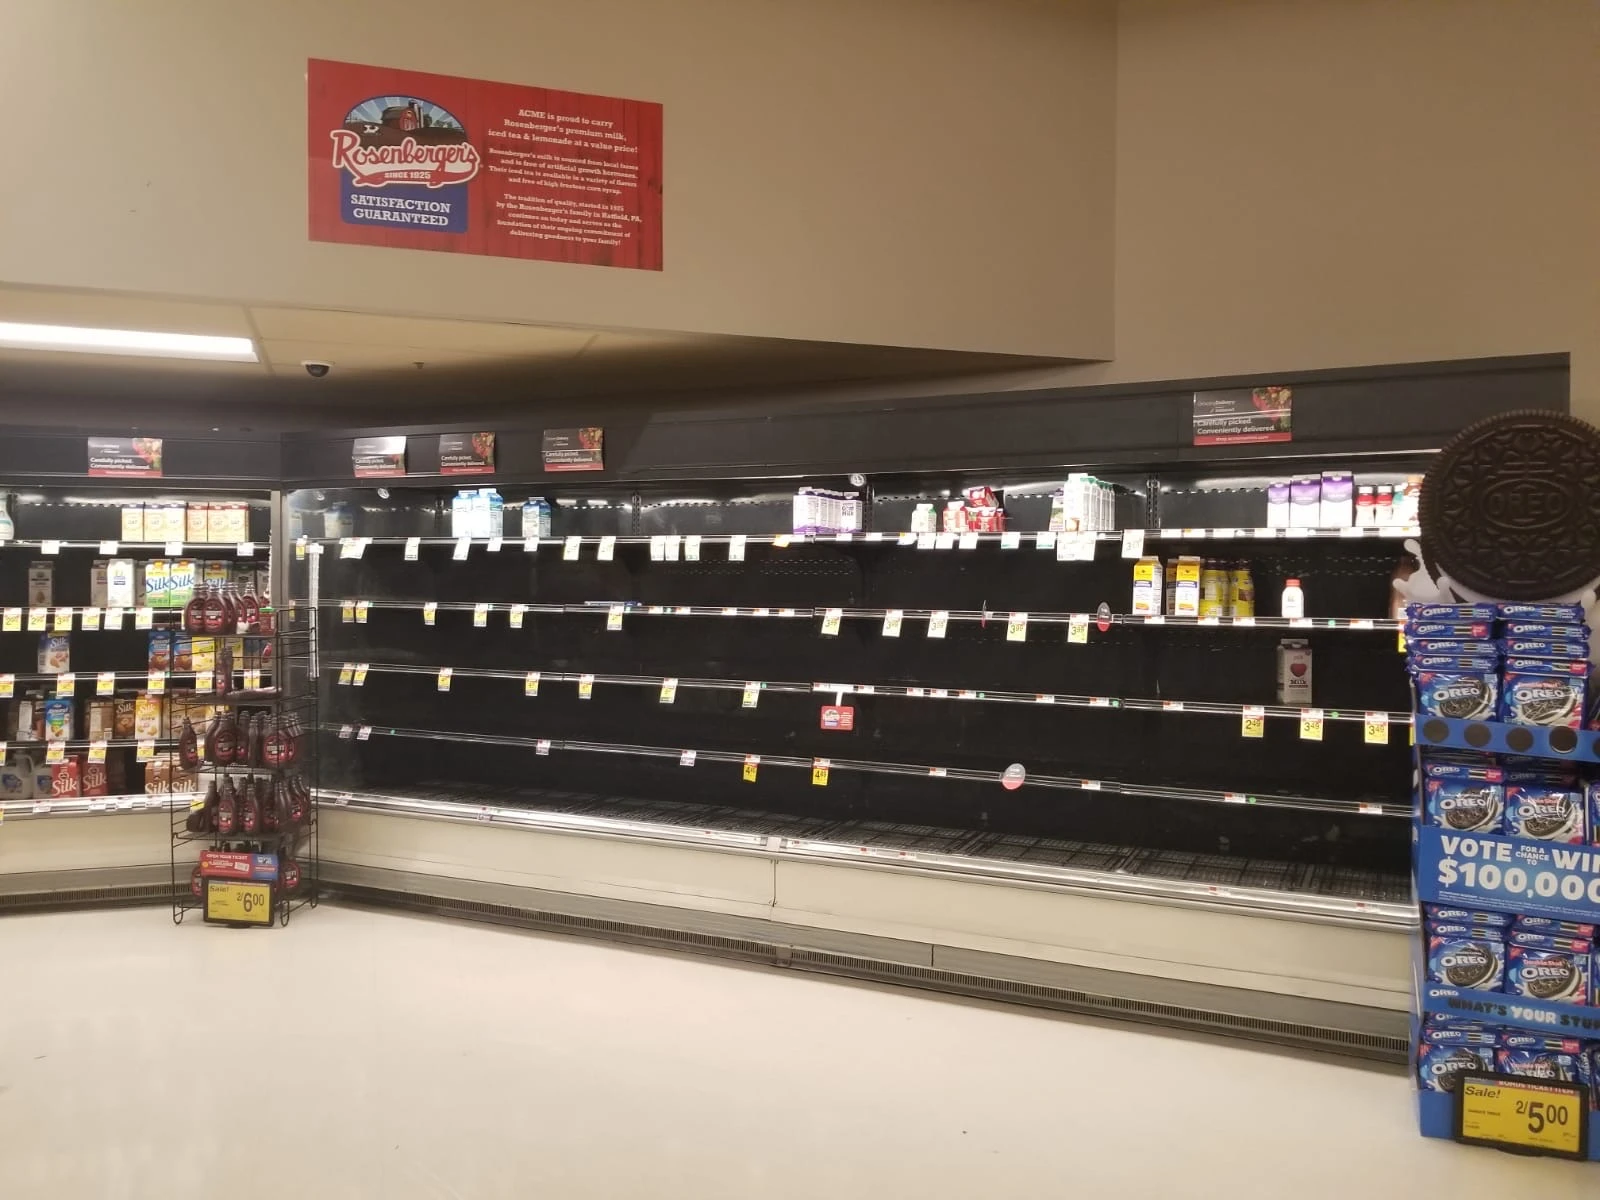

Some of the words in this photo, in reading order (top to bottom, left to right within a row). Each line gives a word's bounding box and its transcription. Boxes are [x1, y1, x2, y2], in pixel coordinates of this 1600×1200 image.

[518, 109, 546, 118] ACME
[591, 120, 613, 128] carry
[504, 119, 564, 132] Rosenberger's
[566, 128, 603, 137] premium
[605, 133, 626, 141] milk,
[488, 129, 506, 137] iced
[532, 134, 572, 145] lemonade
[590, 142, 612, 150] value
[332, 130, 479, 186] Rosenberger's
[384, 171, 408, 179] SINCE
[410, 171, 431, 179] 1925
[351, 194, 451, 213] SATISFACTION
[353, 208, 448, 226] GUARANTEED
[146, 577, 171, 593] Silk
[170, 574, 194, 591] Silk
[1423, 608, 1453, 616] OREO
[1504, 605, 1535, 614] OREO
[1417, 624, 1445, 633] OREO
[1513, 624, 1545, 633] OREO
[50, 637, 66, 648] Silk
[1427, 641, 1457, 650] OREO
[1513, 642, 1546, 650] OREO
[1422, 656, 1452, 664] OREO
[1433, 687, 1480, 701] OREO
[1516, 689, 1564, 701] OREO
[116, 702, 133, 714] Silk
[52, 778, 76, 796] Silk
[83, 772, 107, 791] Silk
[145, 780, 170, 793] Silk
[171, 780, 196, 792] Silk
[1440, 798, 1486, 810] OREO
[1518, 805, 1565, 817] OREO
[1440, 835, 1513, 862] VOTE
[1515, 851, 1549, 861] CHANCE
[1518, 933, 1545, 941] OREO
[1441, 956, 1487, 967] OREO
[1522, 967, 1569, 979] OREO
[1430, 989, 1459, 997] OREO
[1448, 998, 1507, 1016] WHAT'S
[1511, 1006, 1557, 1024] YOUR
[1432, 1031, 1461, 1039] OREO
[1508, 1037, 1535, 1045] OREO
[1432, 1062, 1476, 1075] OREO
[1465, 1086, 1501, 1098] Sale!
